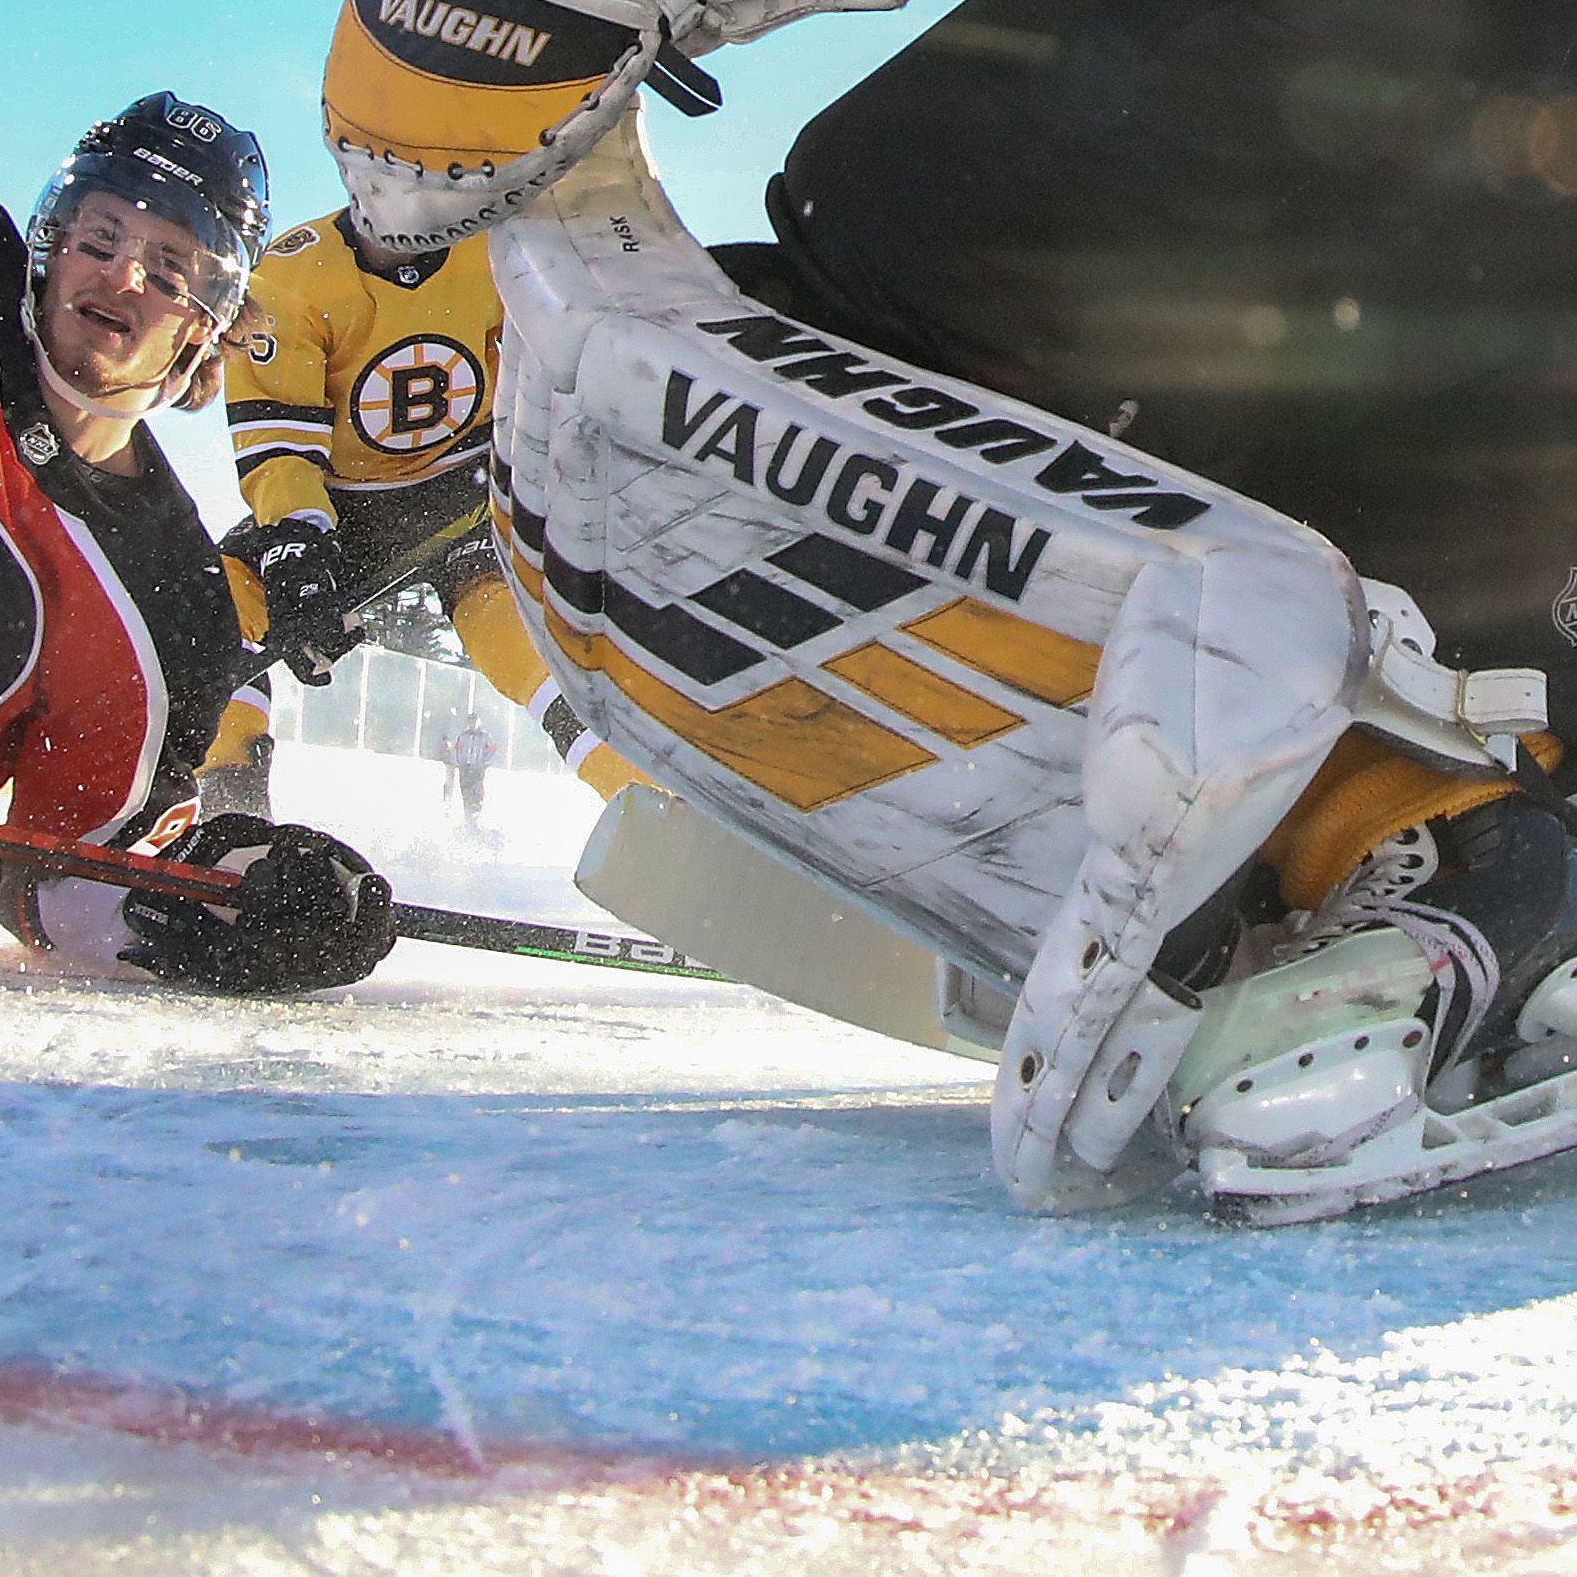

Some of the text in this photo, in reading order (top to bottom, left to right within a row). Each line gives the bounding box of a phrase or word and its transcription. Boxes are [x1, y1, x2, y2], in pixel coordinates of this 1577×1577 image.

[132, 146, 204, 187] BAUER
[166, 107, 222, 142] 86
[661, 365, 1053, 602] VAUGHN
[695, 315, 1214, 530] VAUGHN
